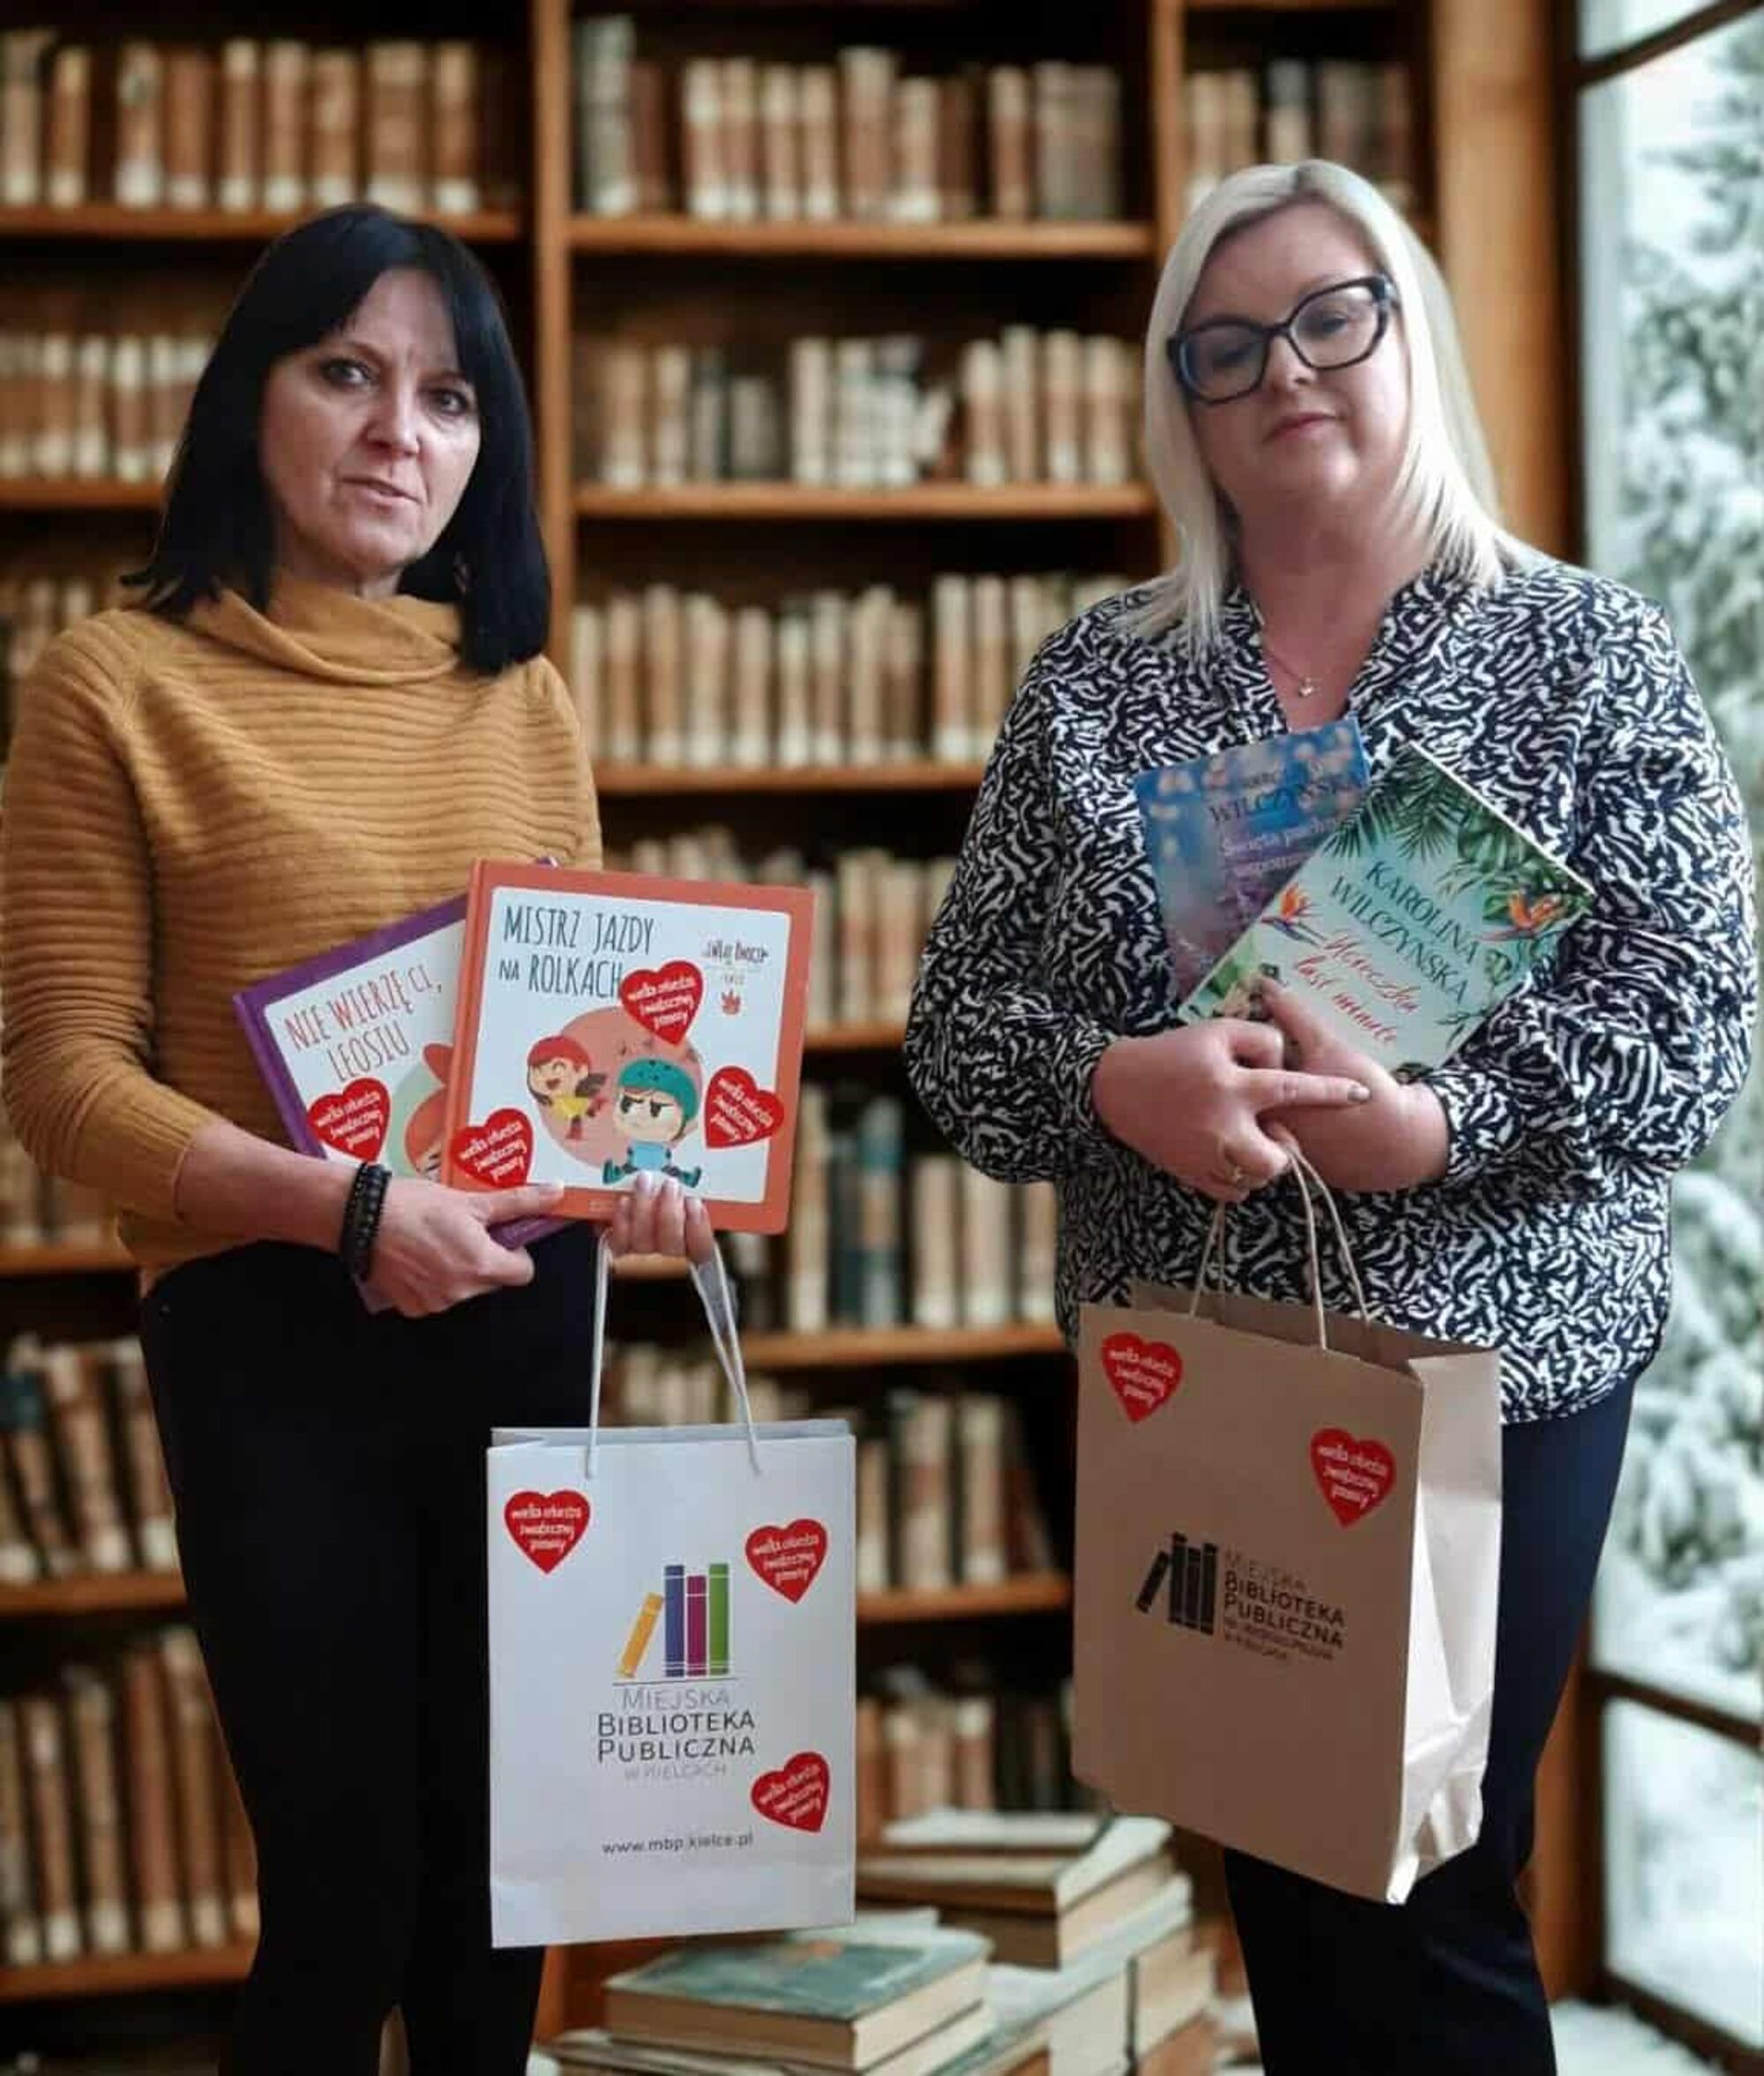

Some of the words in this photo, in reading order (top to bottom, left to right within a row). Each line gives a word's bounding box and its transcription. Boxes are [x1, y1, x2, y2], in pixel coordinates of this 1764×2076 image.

[504, 906, 580, 950] MISTRZ
[592, 913, 654, 956] JAZDY
[1365, 860, 1480, 964] KAROLINA
[498, 959, 520, 981] NA
[528, 954, 624, 999] ROLKACH
[284, 1004, 332, 1052] NIE
[326, 970, 414, 1032] WIERZĘ
[326, 1019, 410, 1082] LEOSIU
[1224, 1569, 1345, 1627] BIBLIOTEKA
[1224, 1592, 1344, 1649] PUBLICZNA
[598, 1709, 756, 1737] BIBLIOTEKA
[624, 1687, 729, 1711] MIEJSKA
[598, 1736, 756, 1764] PUBLICZNA
